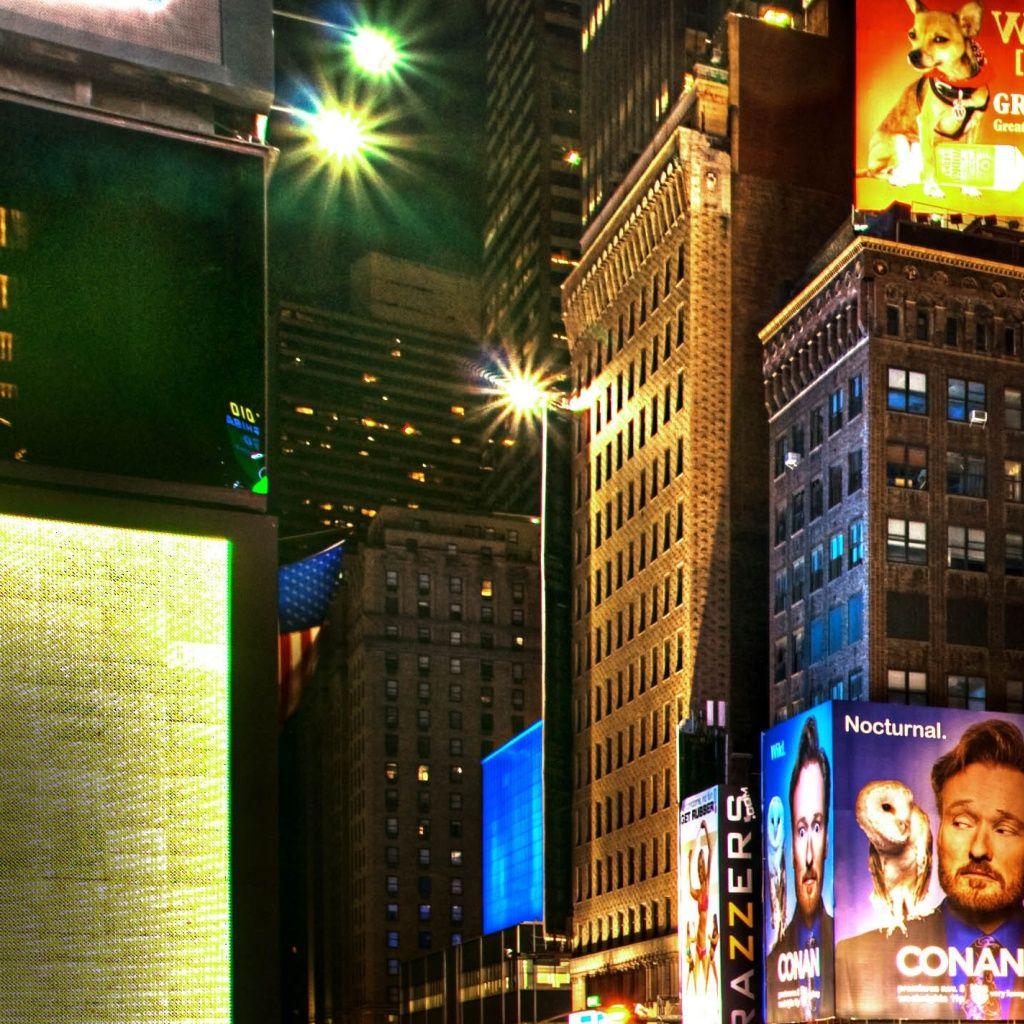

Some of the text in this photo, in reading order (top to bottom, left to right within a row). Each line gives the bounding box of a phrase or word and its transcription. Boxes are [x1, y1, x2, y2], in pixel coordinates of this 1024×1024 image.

[845, 716, 947, 740] Nocturnal.
[778, 947, 820, 982] CONAN
[896, 945, 1024, 977] CONAN
